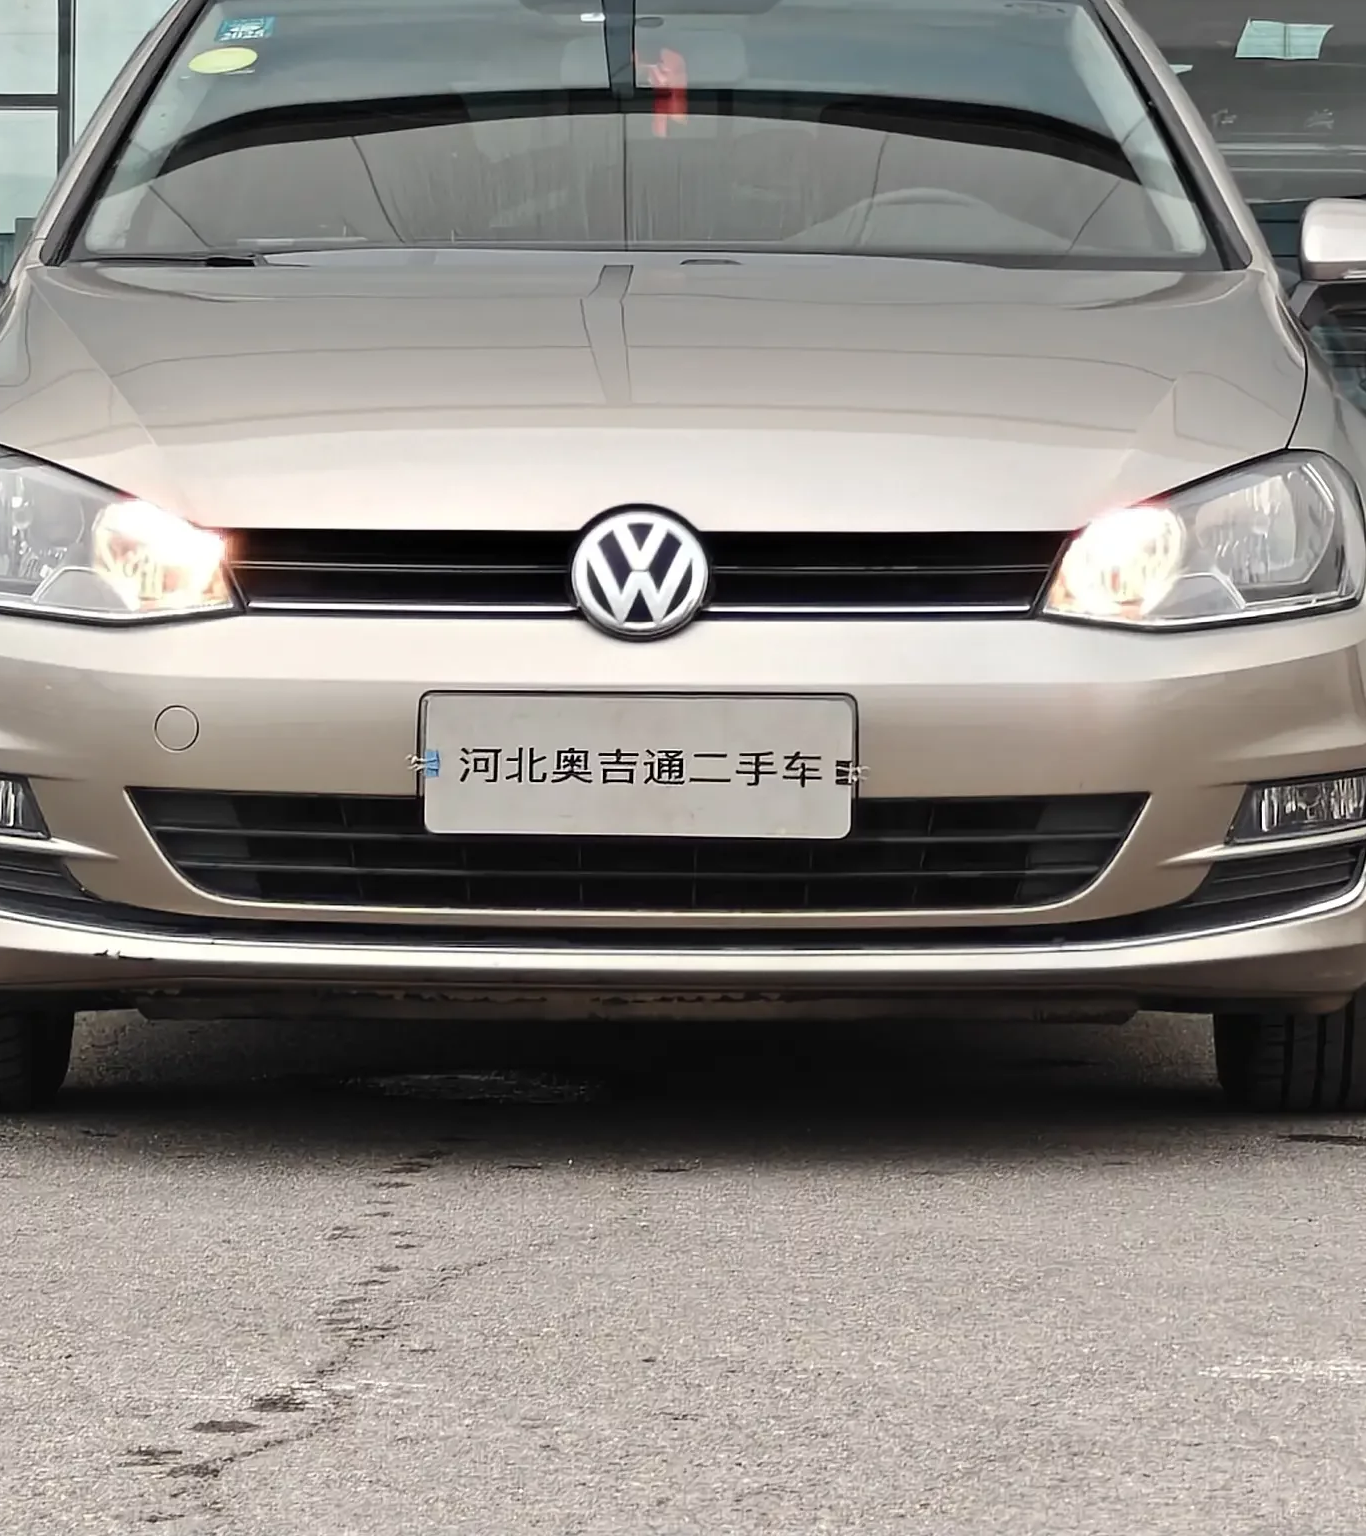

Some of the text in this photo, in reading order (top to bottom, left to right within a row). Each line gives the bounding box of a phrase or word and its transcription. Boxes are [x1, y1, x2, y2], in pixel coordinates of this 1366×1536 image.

[458, 746, 824, 788] 河北奥吉通二手车
